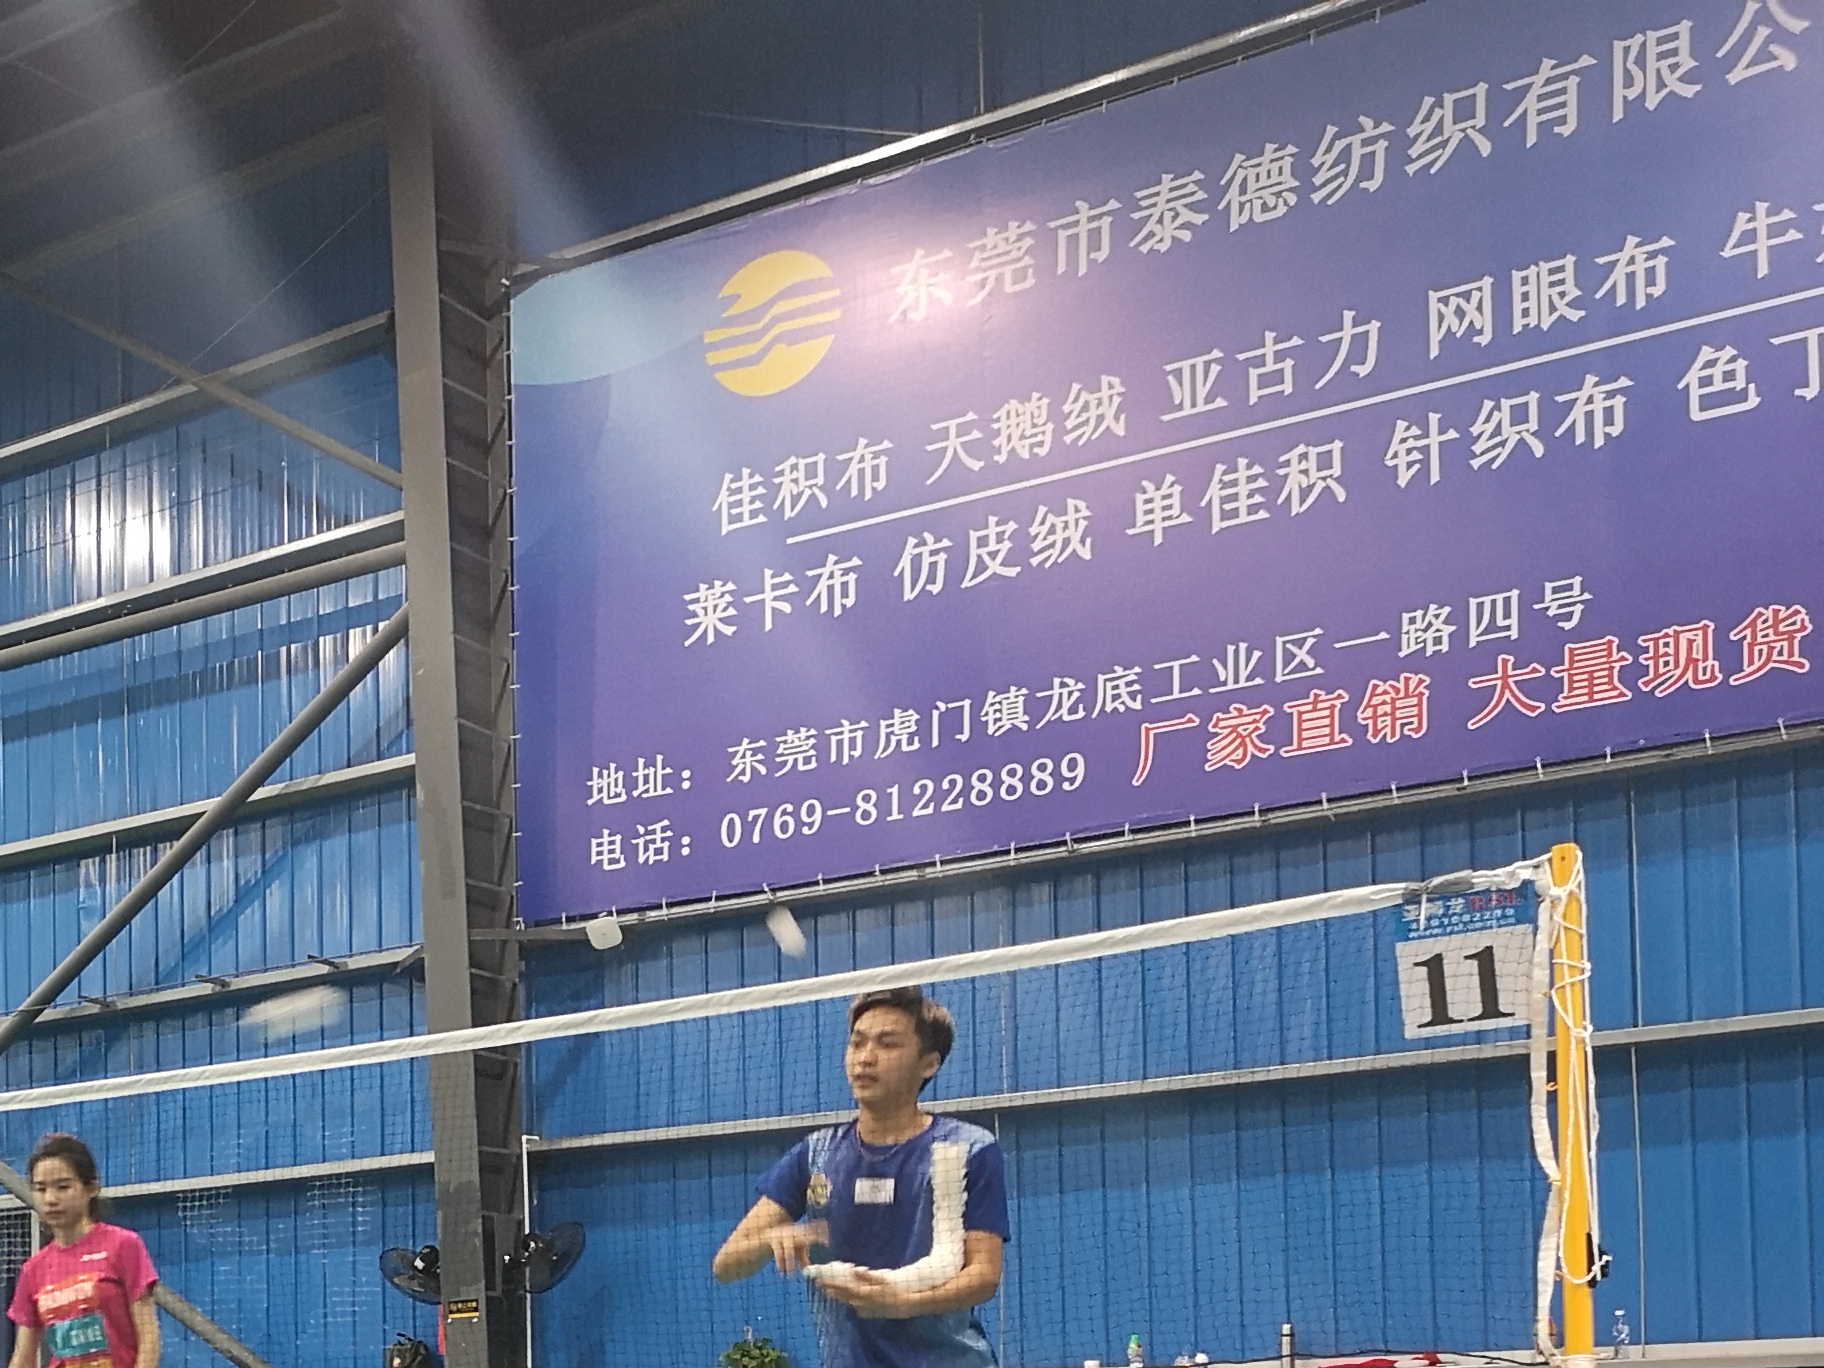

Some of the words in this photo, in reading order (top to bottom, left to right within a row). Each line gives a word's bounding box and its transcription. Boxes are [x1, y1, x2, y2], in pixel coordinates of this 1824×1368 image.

[888, 0, 1811, 324] 东莞市泰德纺织有限公
[712, 437, 894, 536] 佳积布
[925, 374, 1126, 485] 天鹅绒
[1159, 310, 1382, 422] 亚古力
[1428, 235, 1676, 359] 网眼布
[1719, 201, 1824, 280] 牛
[683, 553, 864, 648] 莱卡布
[892, 497, 1093, 602] 仿皮绒
[1124, 439, 1348, 546] 单佳积
[1383, 373, 1635, 489] 针织布
[719, 752, 1087, 849] 0769-81228889
[1132, 673, 1431, 787] 厂家直销
[1467, 603, 1812, 730] 大量现货
[725, 575, 1594, 784] 东莞市虎门镇龙底工业区一路四号
[1412, 944, 1516, 1029] 11
